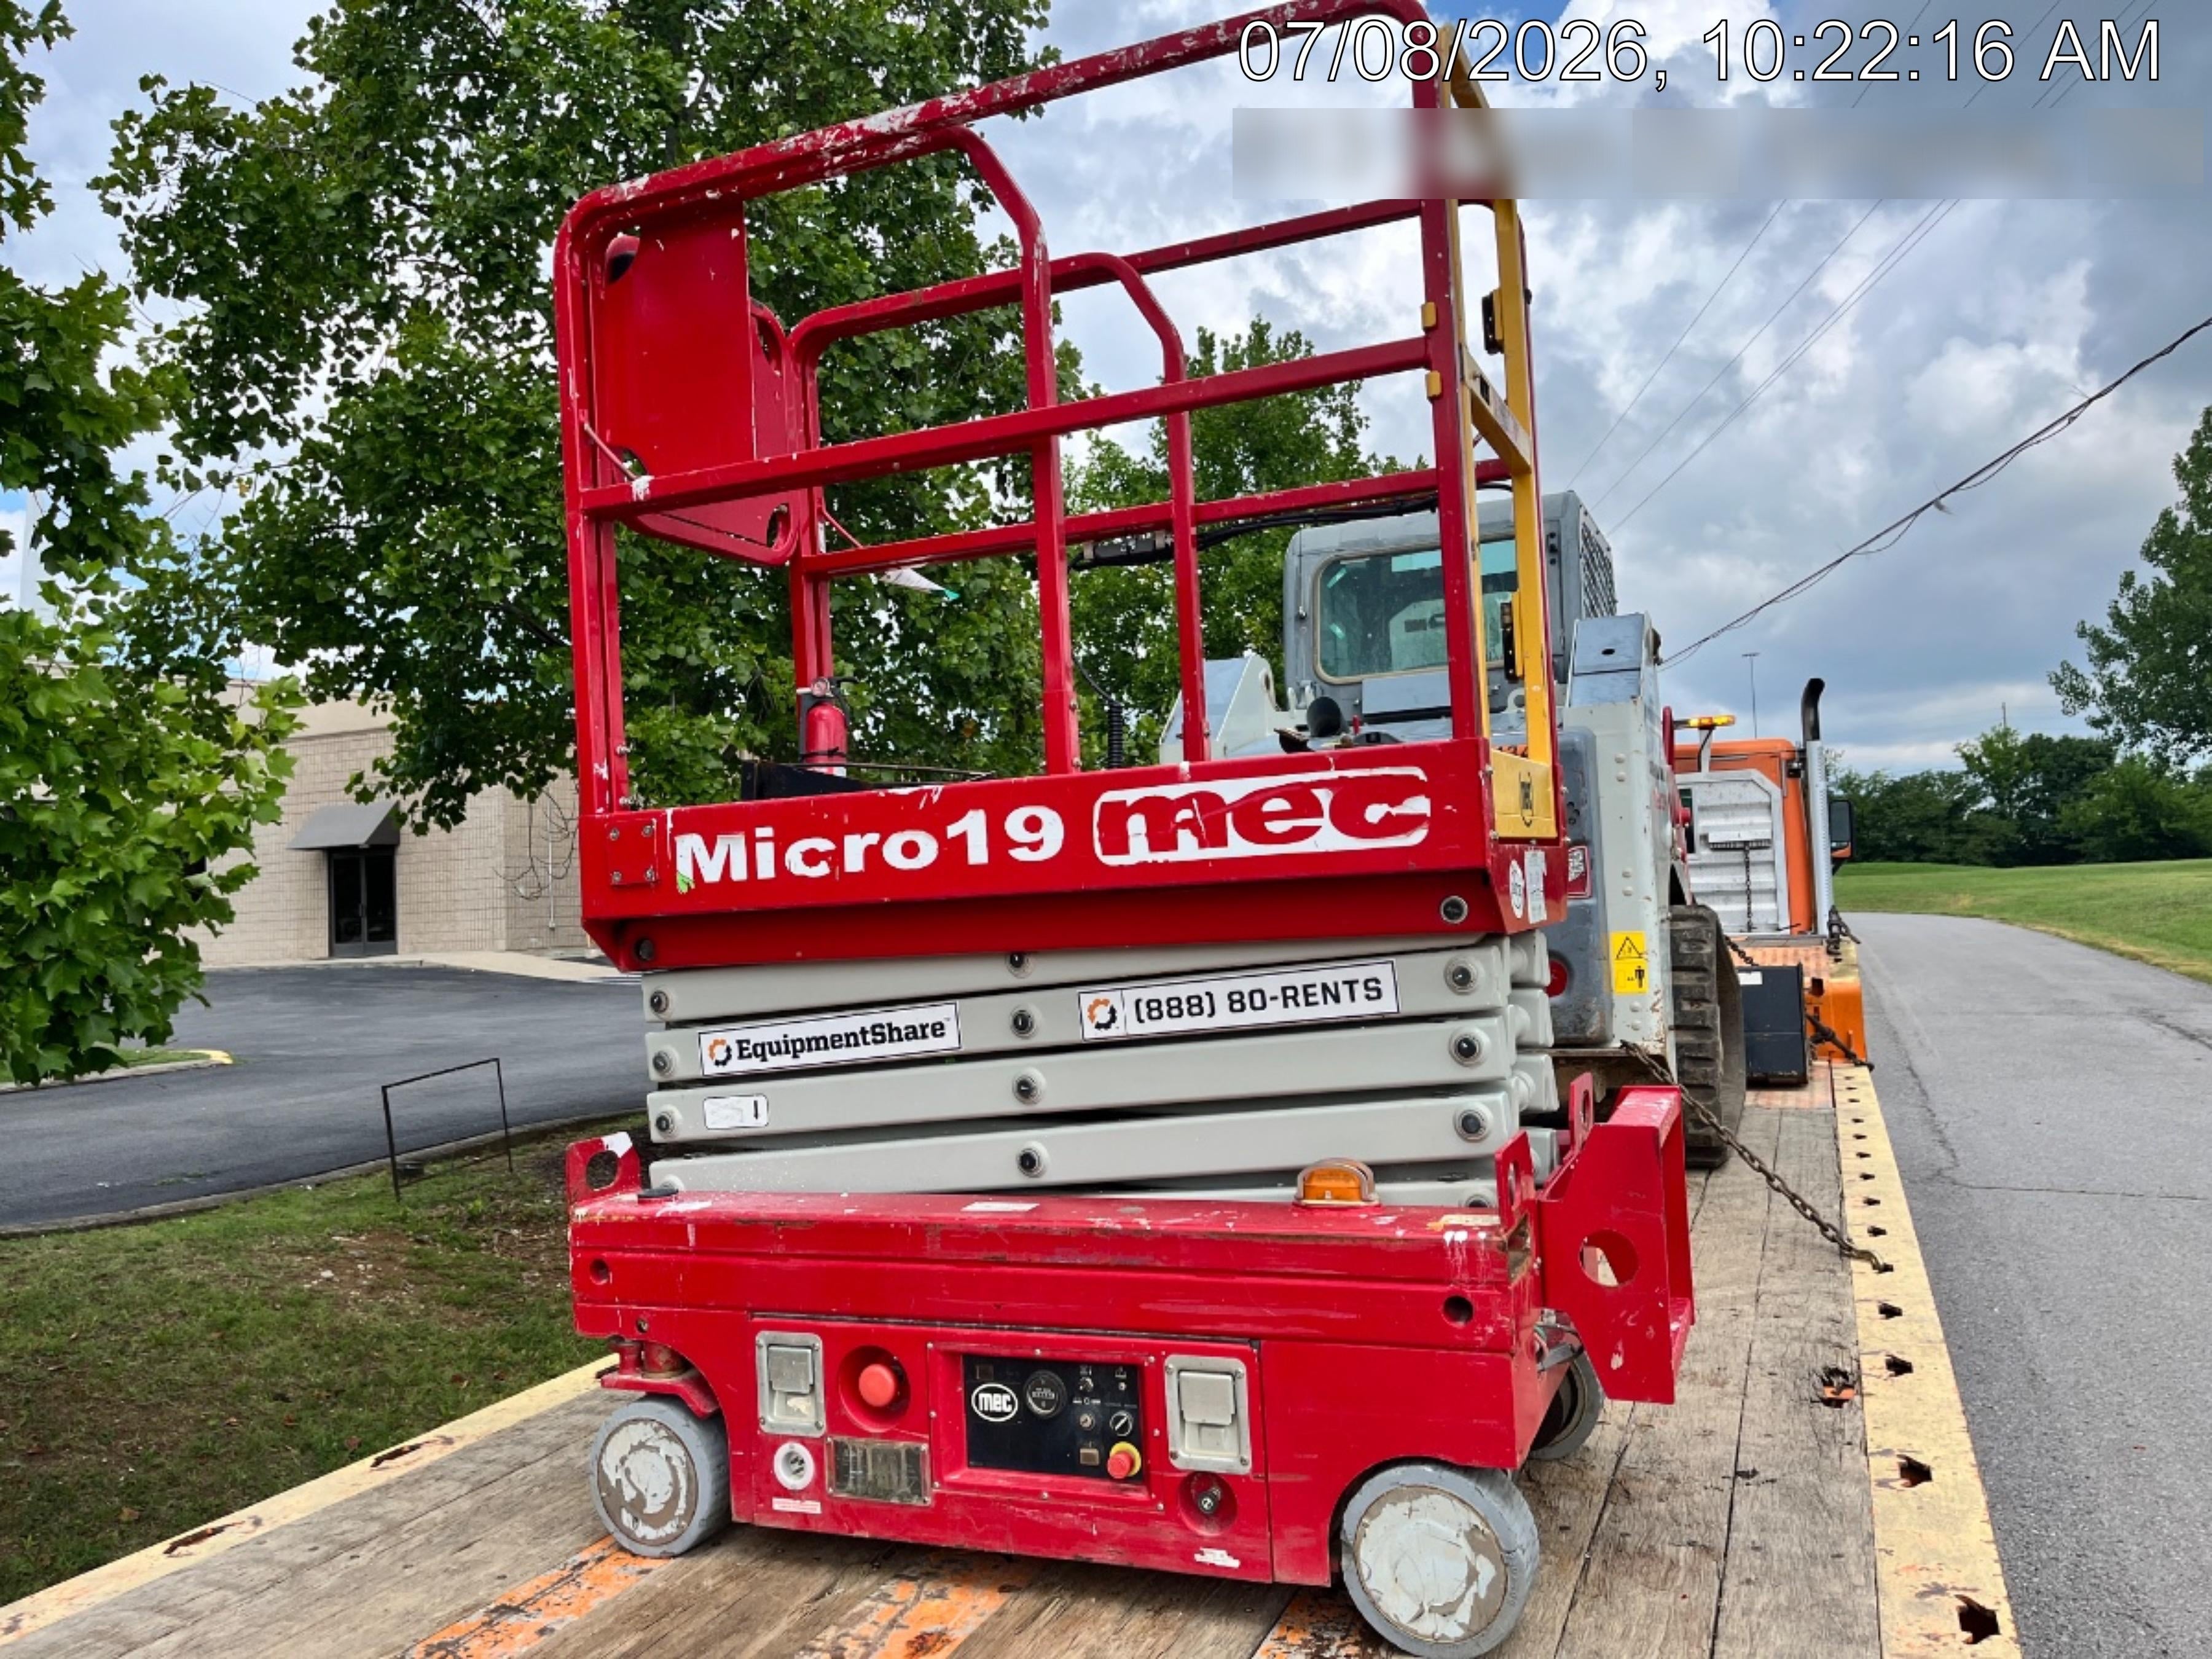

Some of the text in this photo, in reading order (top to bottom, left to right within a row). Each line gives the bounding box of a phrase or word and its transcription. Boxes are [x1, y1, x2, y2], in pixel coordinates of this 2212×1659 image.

[675, 805, 1065, 884] Micro19
[1134, 976, 1383, 1024] (888) 80-RENTS
[737, 1019, 946, 1062] EquipmentShare
